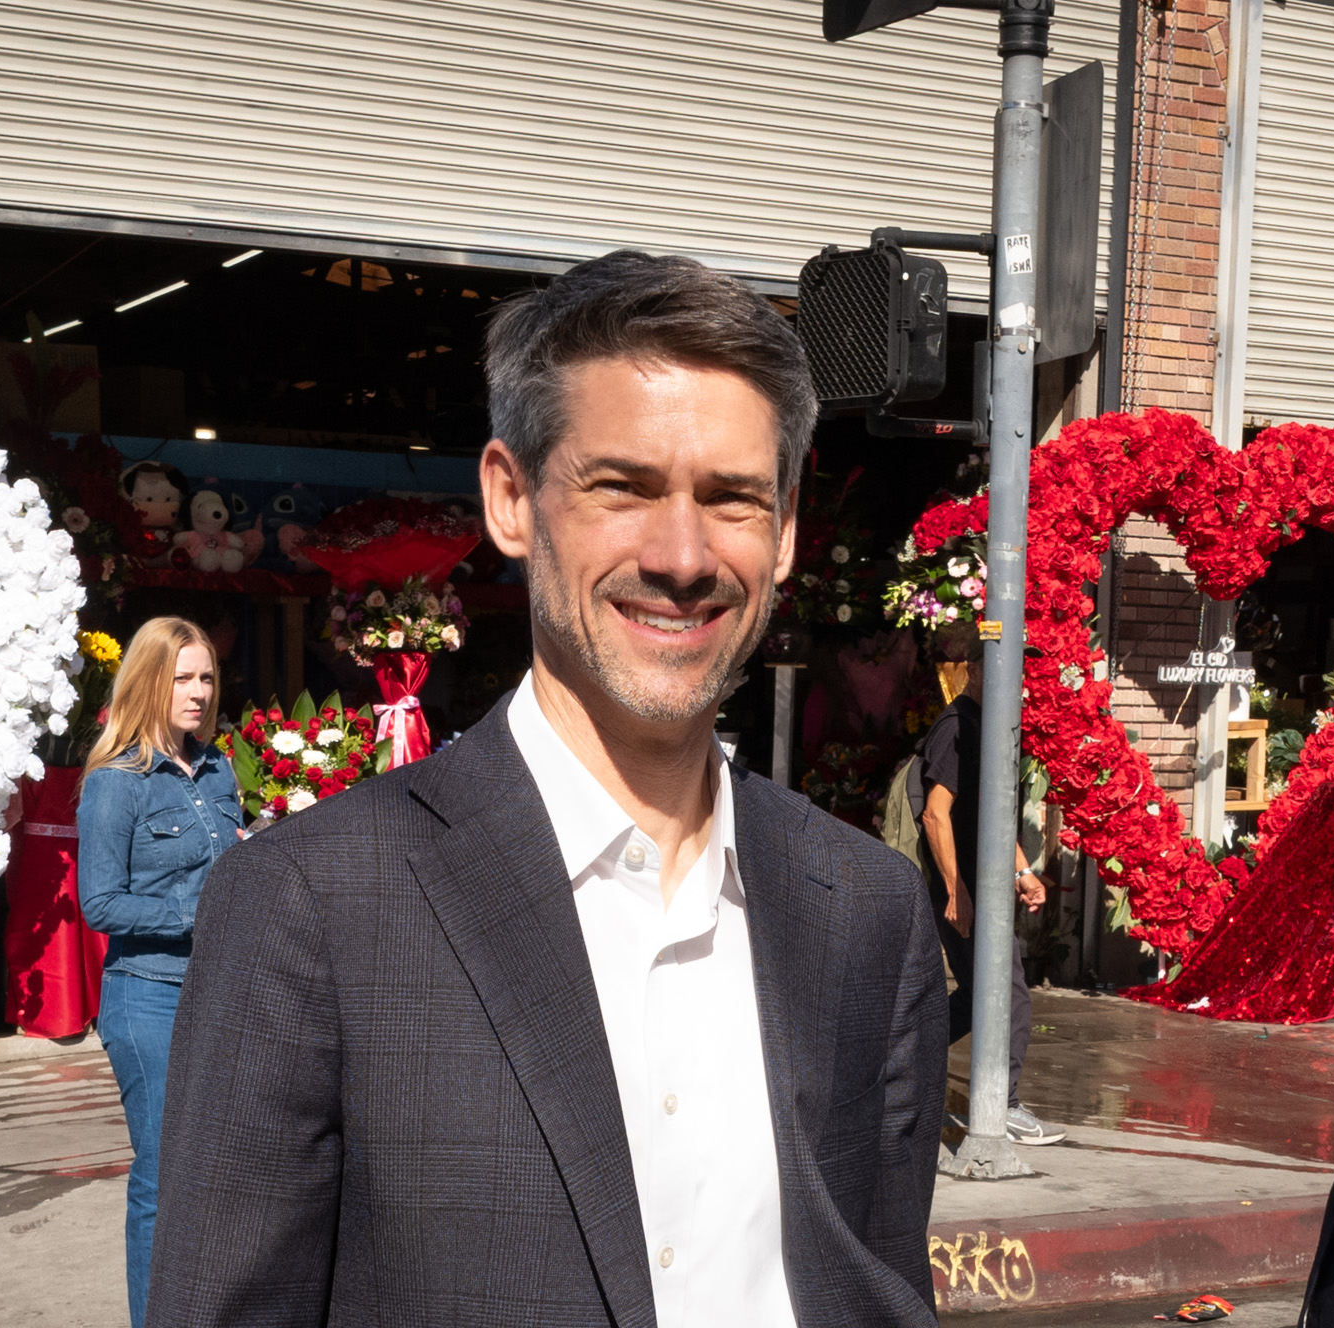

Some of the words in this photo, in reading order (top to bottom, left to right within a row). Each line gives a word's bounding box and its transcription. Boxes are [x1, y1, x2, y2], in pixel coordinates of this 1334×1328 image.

[1191, 652, 1206, 666] EL
[1159, 666, 1205, 683] LUXURY
[1205, 668, 1256, 684] FLOWERS
